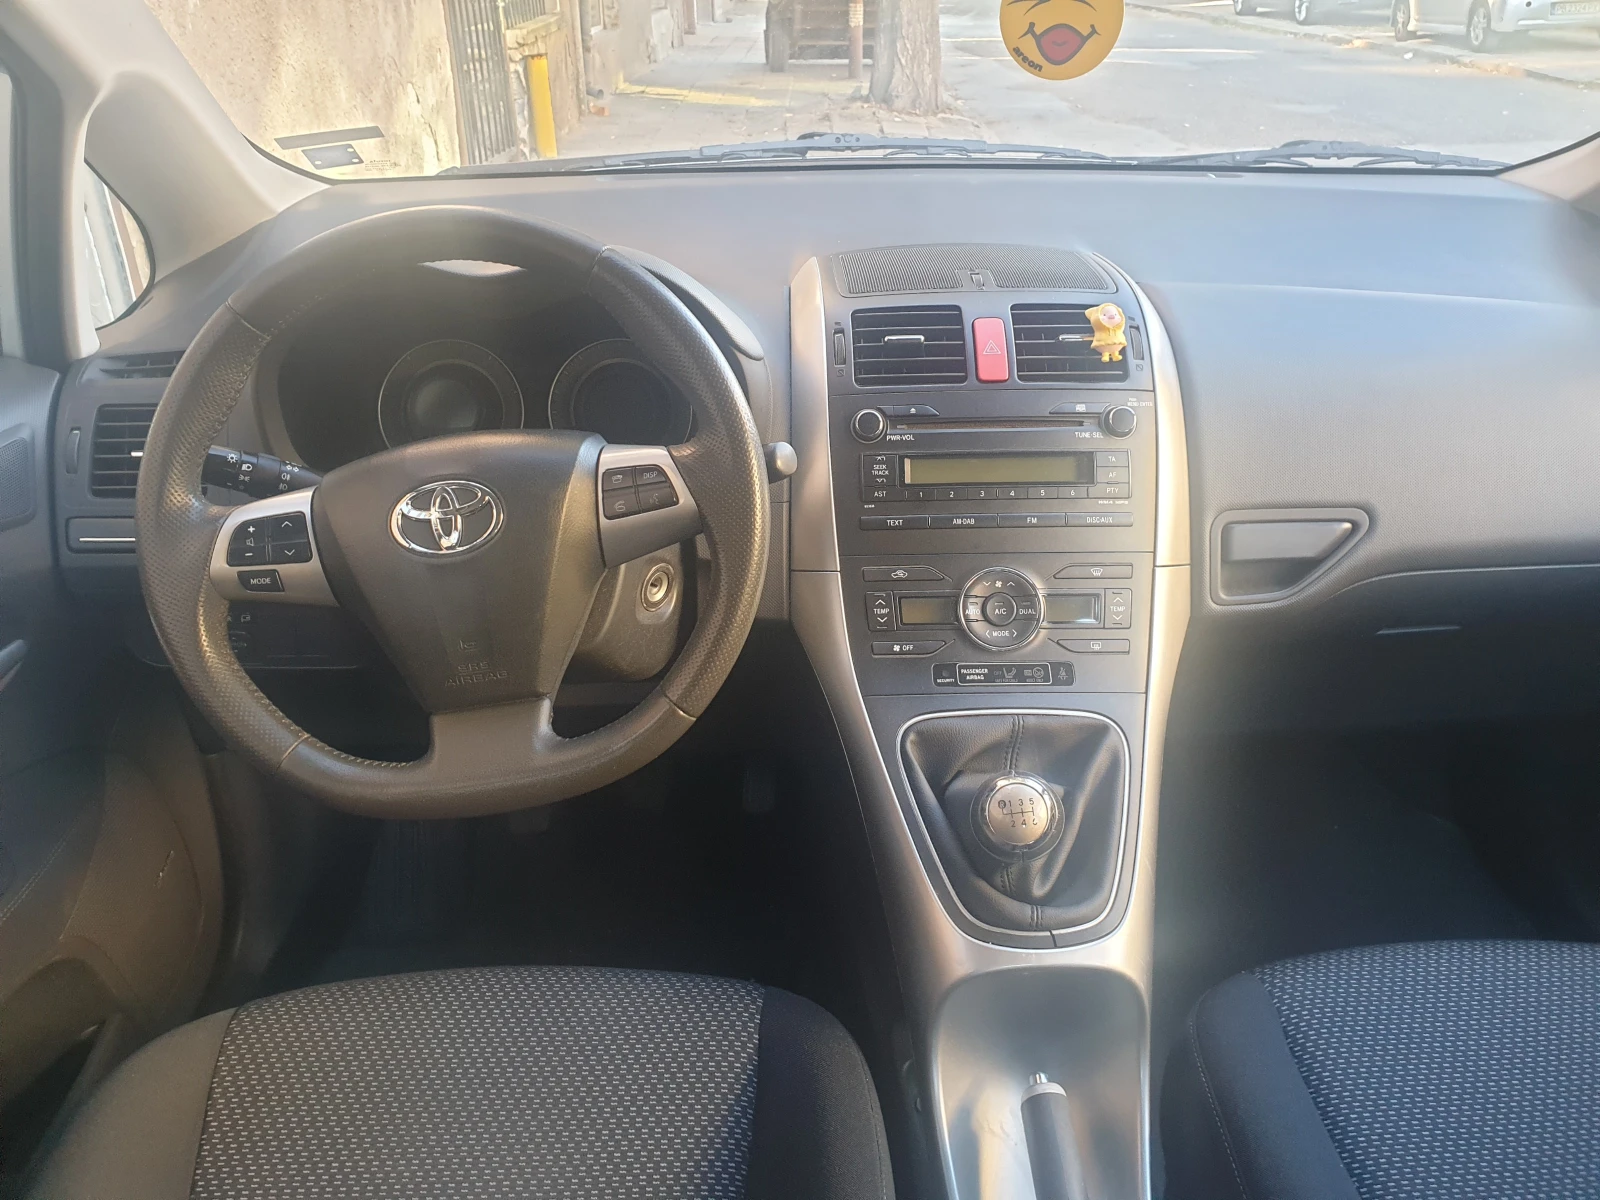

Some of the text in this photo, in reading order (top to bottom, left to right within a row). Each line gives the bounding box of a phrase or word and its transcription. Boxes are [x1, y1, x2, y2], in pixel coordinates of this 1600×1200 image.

[1012, 46, 1043, 72] areon
[643, 471, 658, 479] DISP
[250, 577, 271, 585] MODE
[444, 670, 508, 687] AIRBAG
[1018, 798, 1024, 806] 3
[1011, 820, 1016, 828] 2
